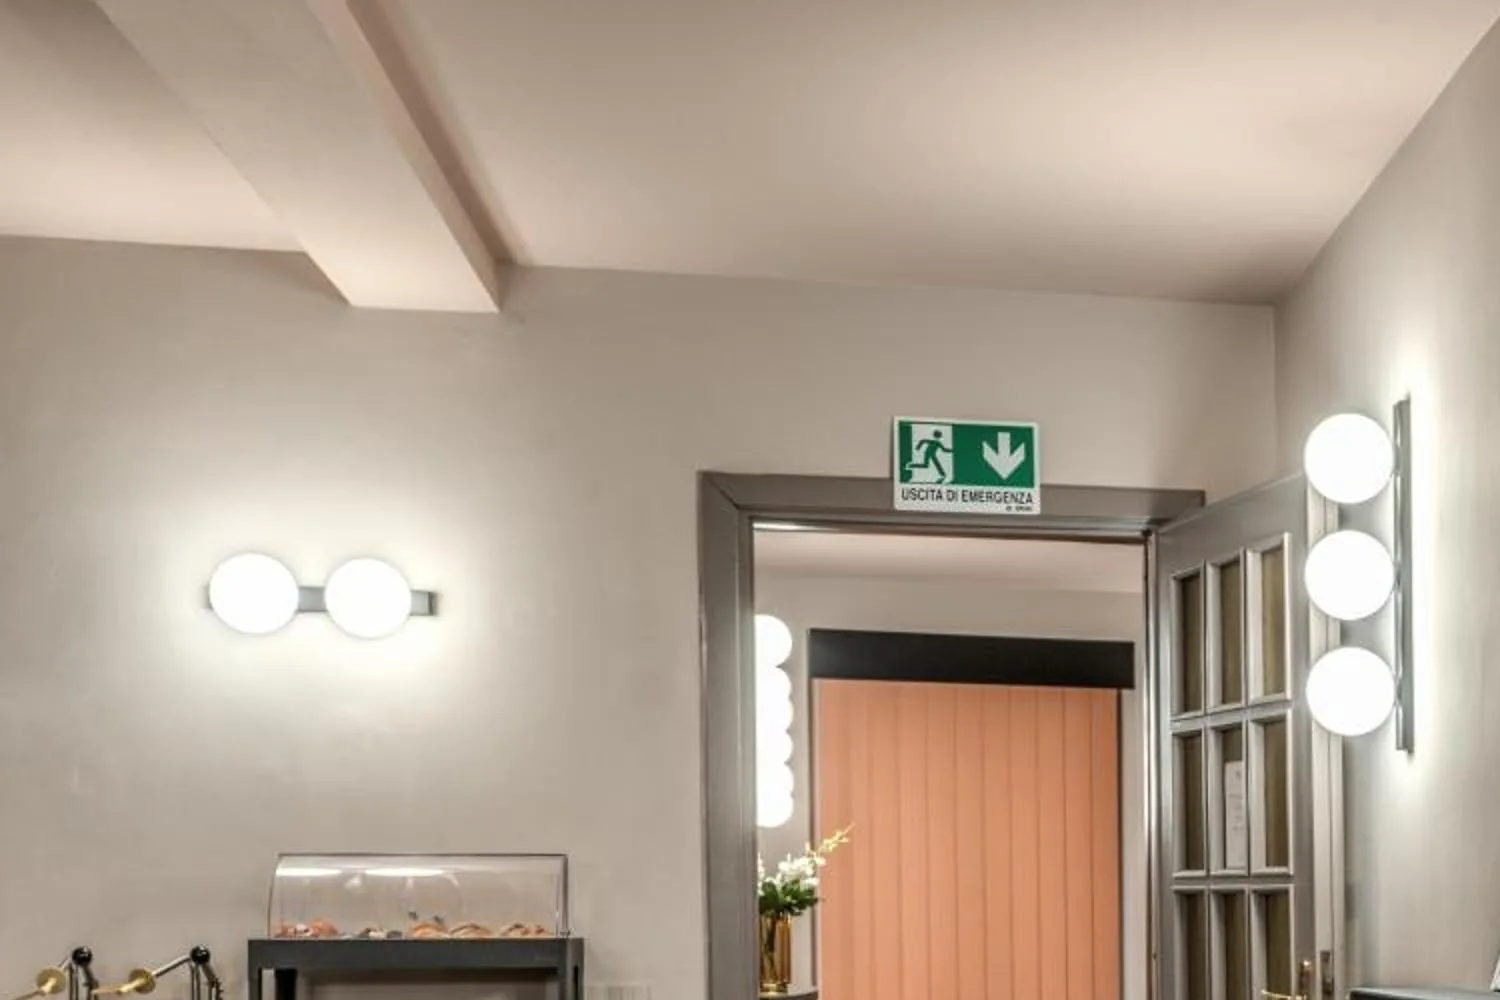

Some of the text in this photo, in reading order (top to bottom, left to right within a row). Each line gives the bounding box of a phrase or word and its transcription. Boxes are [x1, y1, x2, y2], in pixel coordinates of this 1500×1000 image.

[901, 487, 1034, 505] USCITA DI EMERGENZA
